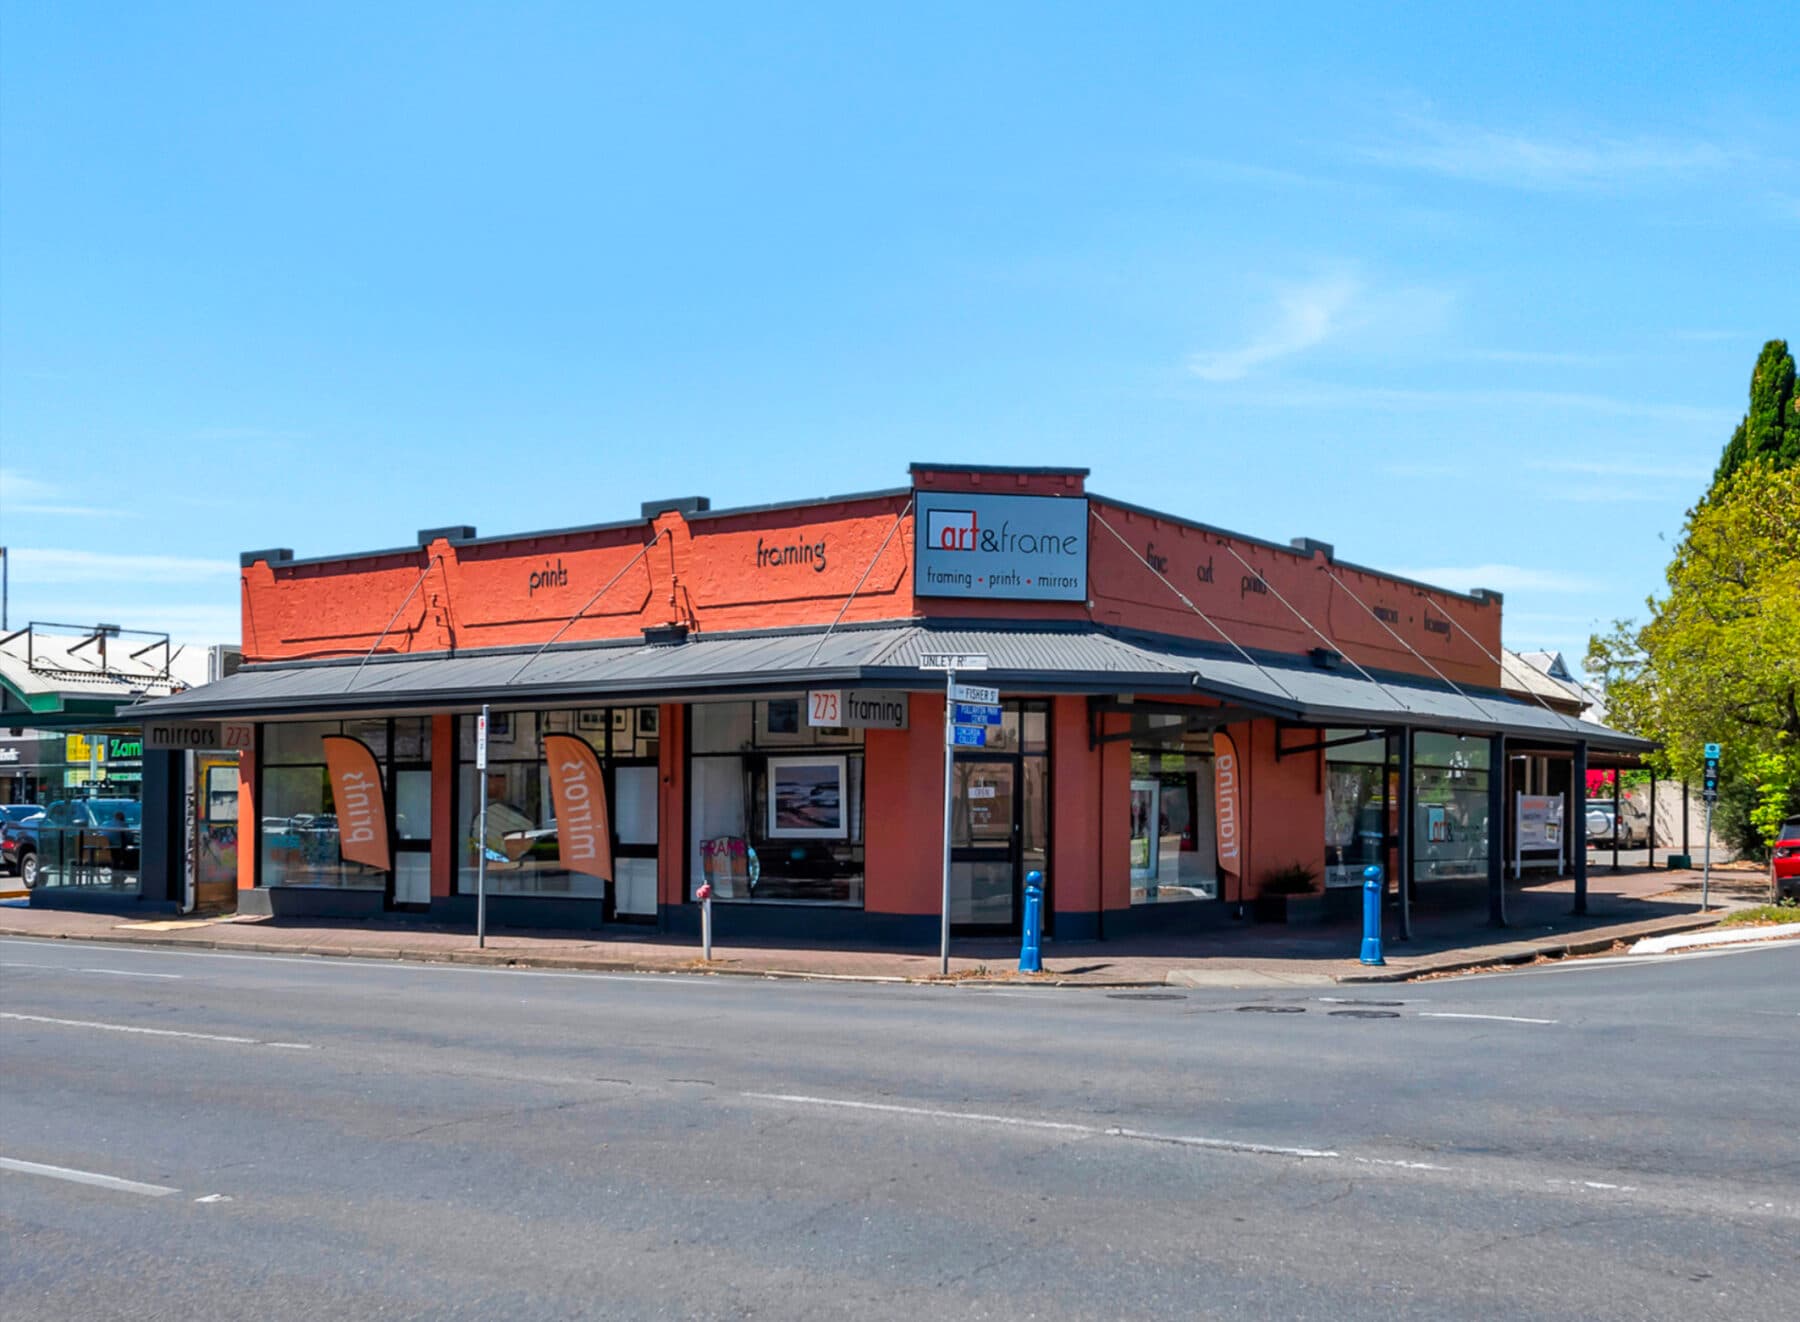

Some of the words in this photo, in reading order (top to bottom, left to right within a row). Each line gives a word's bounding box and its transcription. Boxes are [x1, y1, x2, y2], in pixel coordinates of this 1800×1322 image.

[756, 536, 826, 572] framing
[529, 559, 568, 597] prints
[927, 566, 972, 589] framing
[989, 569, 1021, 589] prints
[1038, 572, 1078, 588] mirrors
[922, 655, 953, 667] UNLEY
[966, 687, 989, 701] FISHER
[813, 693, 838, 722] 273
[849, 691, 903, 728] framing
[152, 726, 215, 746] mirrors
[226, 727, 250, 747] 273
[111, 738, 144, 758] Zam
